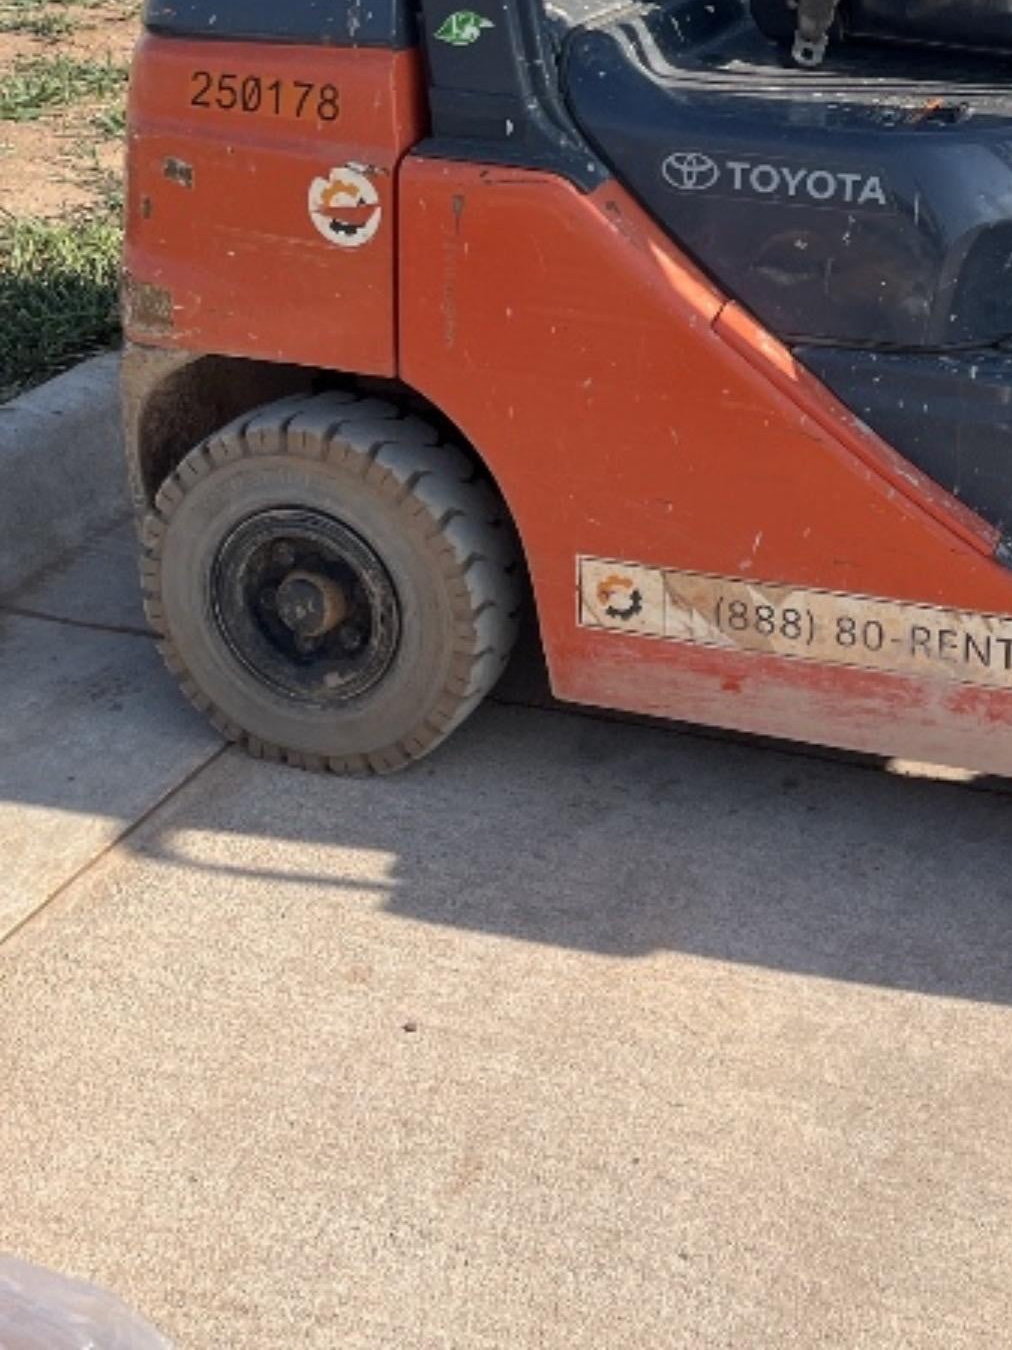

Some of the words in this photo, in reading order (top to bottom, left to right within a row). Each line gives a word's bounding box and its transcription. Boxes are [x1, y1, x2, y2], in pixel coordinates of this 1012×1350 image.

[190, 70, 341, 123] 250178
[725, 161, 887, 205] TOYOTA
[715, 596, 814, 646] (888)
